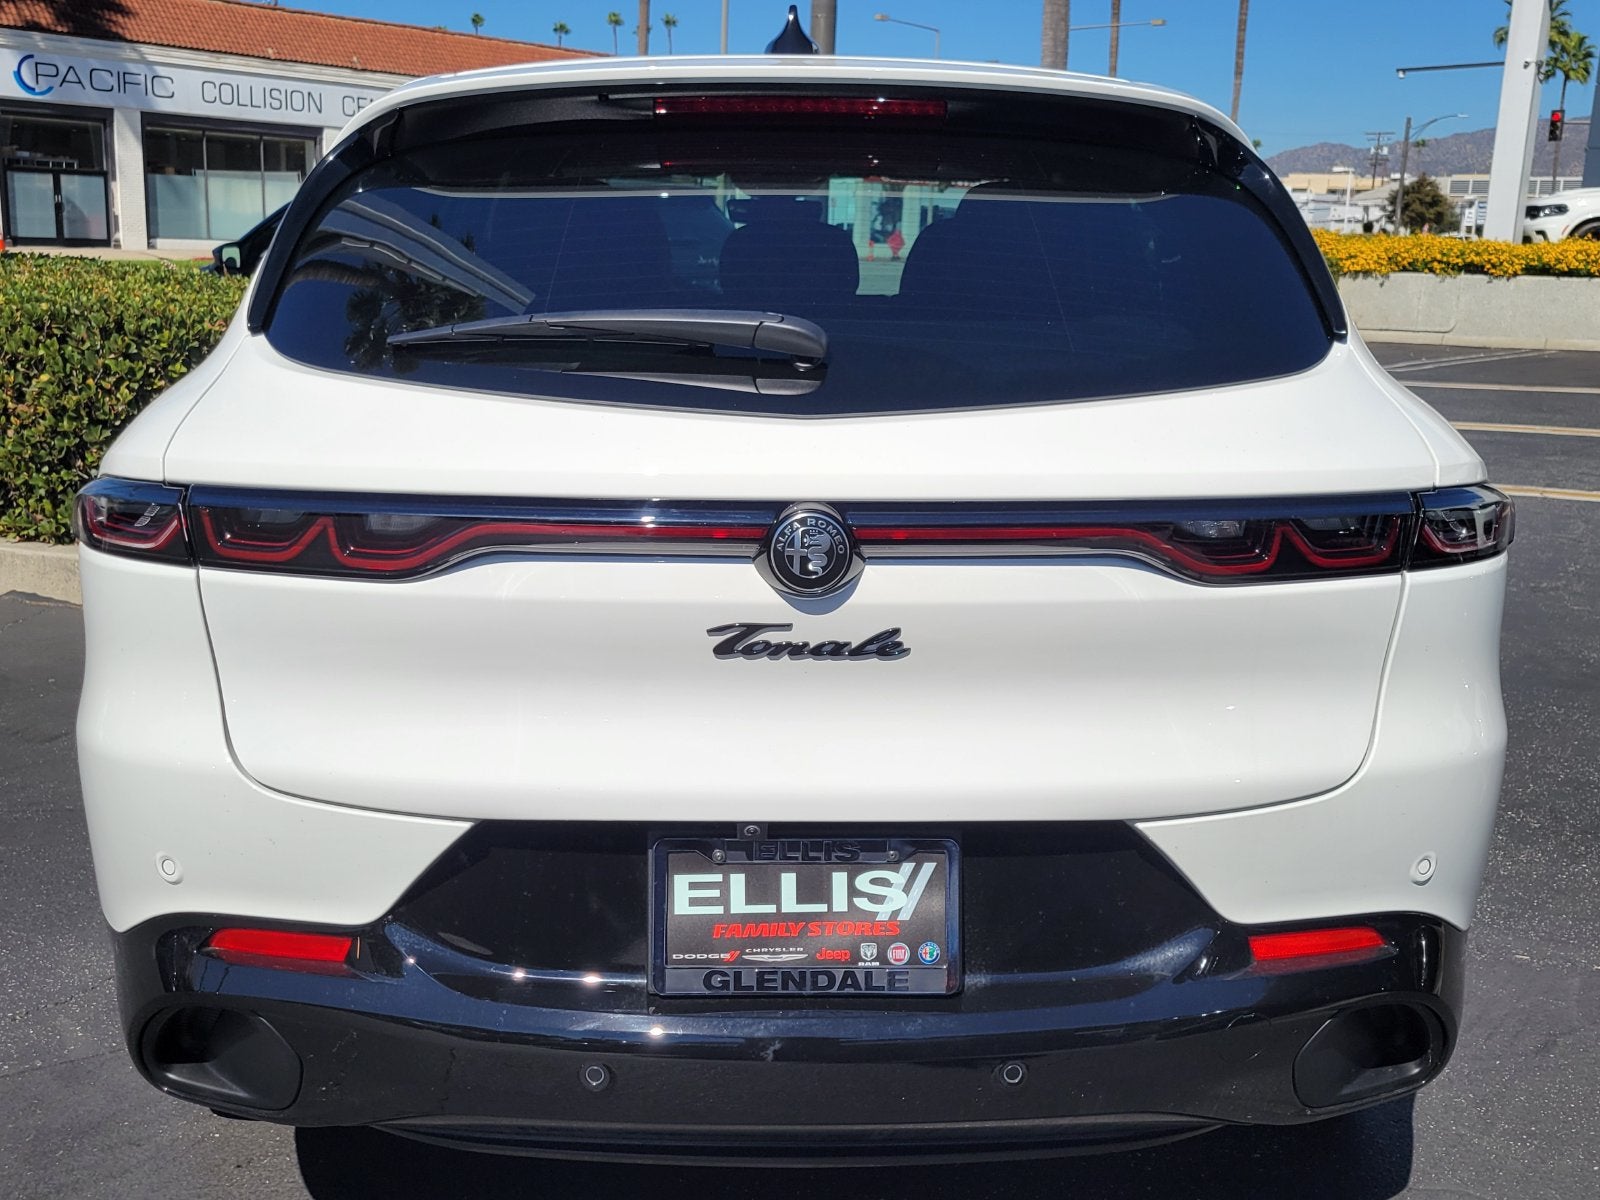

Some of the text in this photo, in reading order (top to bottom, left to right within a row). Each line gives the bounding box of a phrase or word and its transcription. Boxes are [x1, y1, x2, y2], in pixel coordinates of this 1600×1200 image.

[34, 61, 375, 117] PACIFIC COLLISION CE
[776, 518, 845, 554] ALFA ROMEO
[706, 622, 911, 661] Tonale
[753, 840, 861, 861] ELLIS
[673, 869, 908, 915] ELLIS
[712, 920, 900, 939] FAMILY STORES
[816, 947, 851, 962] Jeep
[703, 969, 910, 992] GLENDALE
